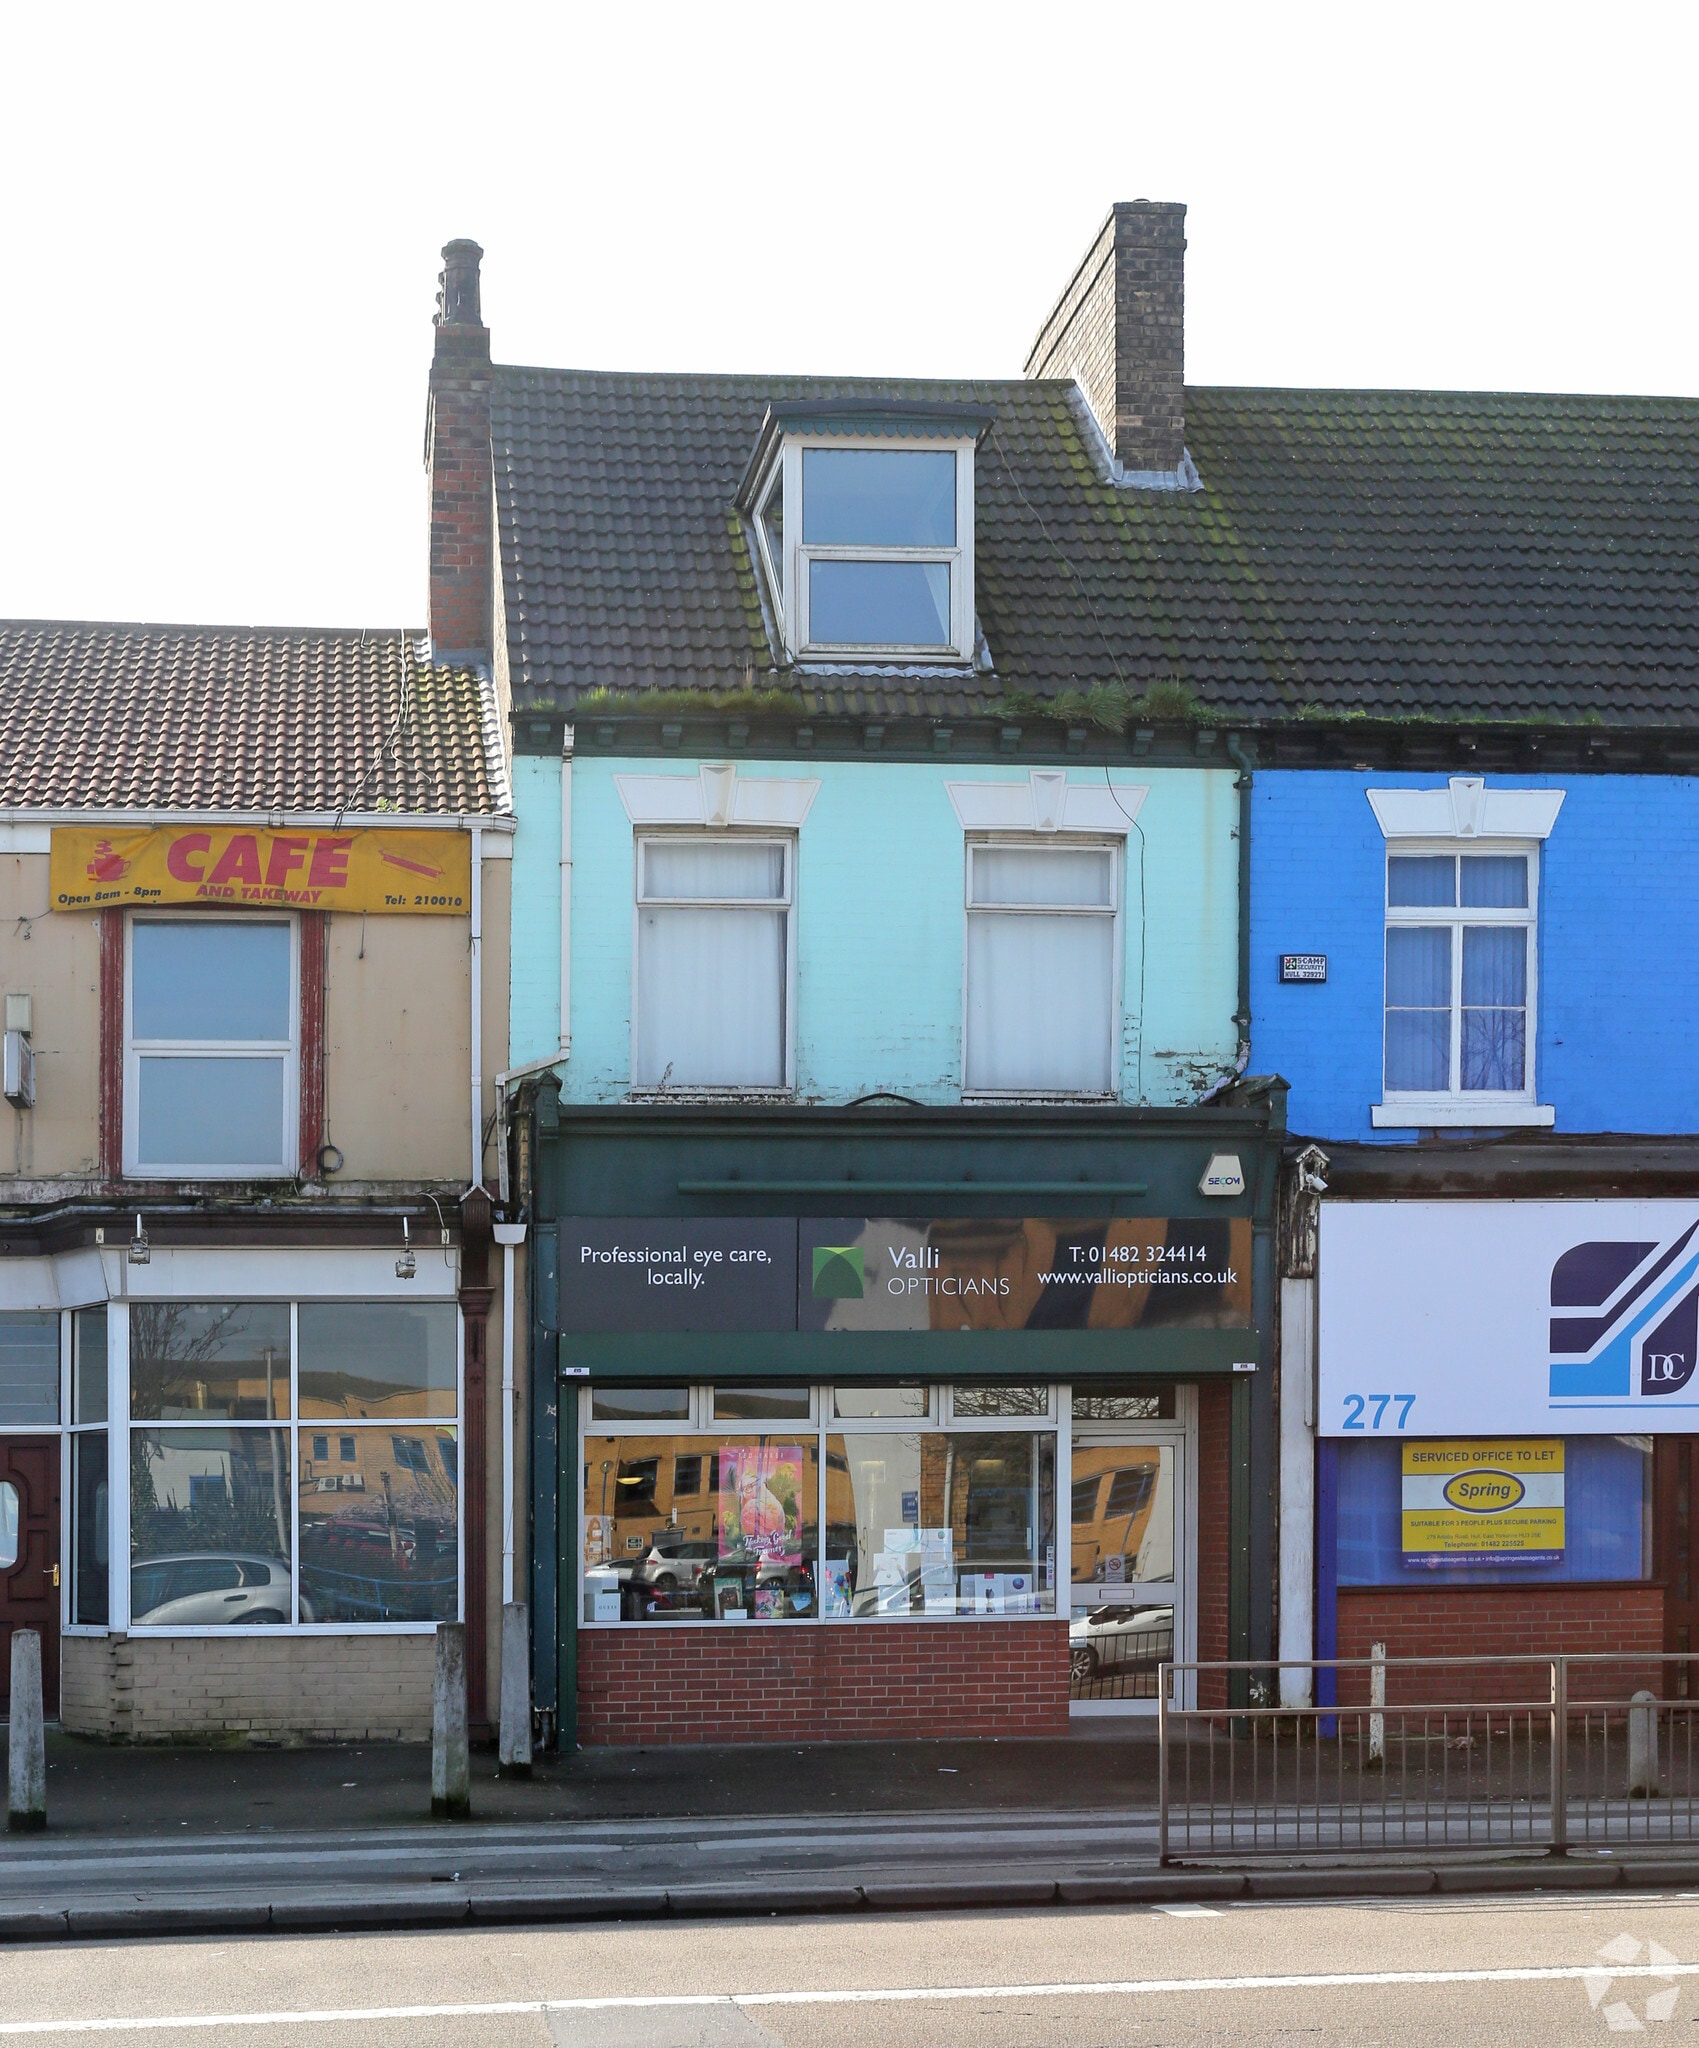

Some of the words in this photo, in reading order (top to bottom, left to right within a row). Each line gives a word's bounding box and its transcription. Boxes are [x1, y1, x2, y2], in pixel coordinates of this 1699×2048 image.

[167, 833, 353, 888] CAFE
[58, 893, 90, 905] Open
[95, 890, 120, 901] 8am
[134, 887, 161, 897] 8pm
[196, 884, 235, 898] AND
[241, 887, 322, 903] TAKEWAY
[385, 895, 406, 905] Tel:
[414, 896, 462, 907] 210010
[1208, 1177, 1240, 1186] SECOM
[581, 1246, 687, 1263] Professional
[693, 1250, 723, 1267] eye
[729, 1250, 772, 1265] care,
[888, 1246, 939, 1269] Valli
[1146, 1246, 1207, 1262] 324414
[648, 1268, 705, 1289] locally.
[887, 1277, 1010, 1295] OPTICIANS
[1037, 1268, 1237, 1288] www.valliopticians.co.uk
[1647, 1353, 1685, 1381] DC
[1342, 1394, 1416, 1430] 277
[1412, 1451, 1469, 1462] SERVICED
[1472, 1451, 1513, 1462] OFFICE
[1517, 1451, 1531, 1461] TO
[1535, 1450, 1555, 1461] LET
[1459, 1482, 1511, 1499] Spring
